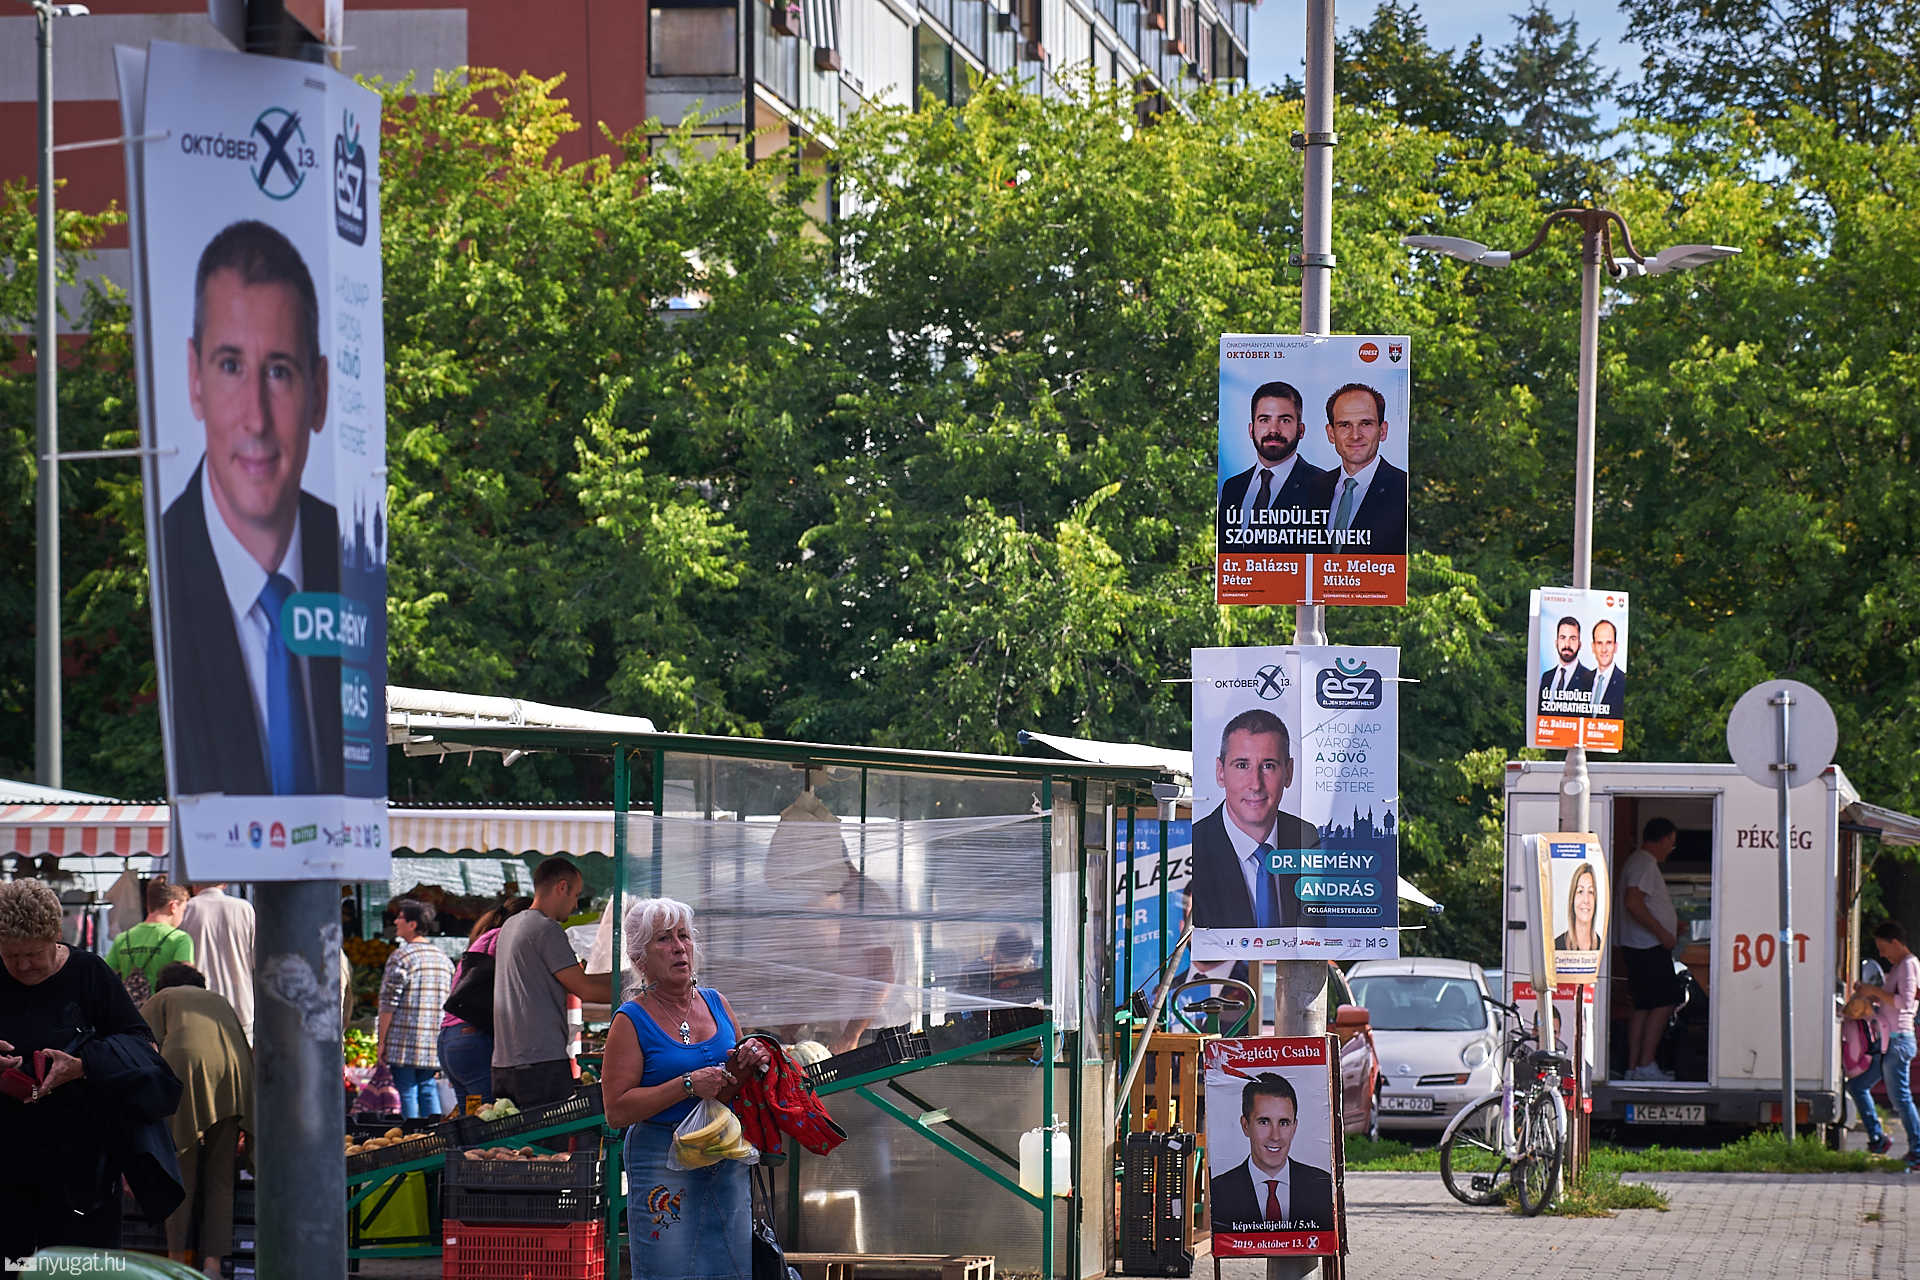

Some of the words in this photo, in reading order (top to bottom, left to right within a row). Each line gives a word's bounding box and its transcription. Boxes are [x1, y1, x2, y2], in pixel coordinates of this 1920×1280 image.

[181, 131, 258, 162] OKTÓBER
[297, 147, 319, 168] 13.
[1226, 350, 1270, 359] OKTÓBER
[1273, 351, 1286, 359] 13.
[1226, 505, 1244, 525] ÚJ
[1250, 505, 1330, 525] LENDÜLET
[1225, 528, 1371, 545] SZOMBATHELYNEK!
[1222, 558, 1241, 572] dr.
[1246, 558, 1299, 575] Balázsy
[1323, 559, 1343, 572] dr.
[1347, 559, 1396, 576] Melega
[1222, 574, 1253, 585] Péter
[1323, 575, 1361, 586] Miklós
[293, 607, 338, 641] DR.
[1214, 676, 1259, 689] OKTÓBER
[1280, 678, 1291, 687] 13.
[1541, 686, 1553, 700] ÚJ
[1554, 688, 1592, 702] LENDÜLET
[1540, 700, 1610, 715] SZOMBATHELYNEK!
[1315, 723, 1325, 735] A
[1327, 723, 1382, 735] HOLNAP
[1315, 735, 1373, 750] VÁROSA,
[1315, 752, 1326, 763] A
[1327, 750, 1367, 763] JÖVŐ
[1315, 764, 1375, 778] POLGÁR-
[1315, 780, 1375, 793] MESTERE
[1736, 824, 1813, 850] PÉKÉG
[1136, 841, 1151, 850] 13.
[1271, 855, 1297, 869] DR.
[1301, 852, 1374, 869] NEMÉNY
[1301, 879, 1375, 897] ANDRÁS
[1733, 932, 1811, 973] BOT
[1229, 1046, 1280, 1063] eglédy
[1281, 1045, 1321, 1059] Csaba
[1636, 1106, 1702, 1120] KEA-417
[1299, 1219, 1320, 1229] 5.vk.
[1232, 1240, 1255, 1249] 2019.
[1257, 1239, 1290, 1249] október
[1292, 1239, 1305, 1248] 13.
